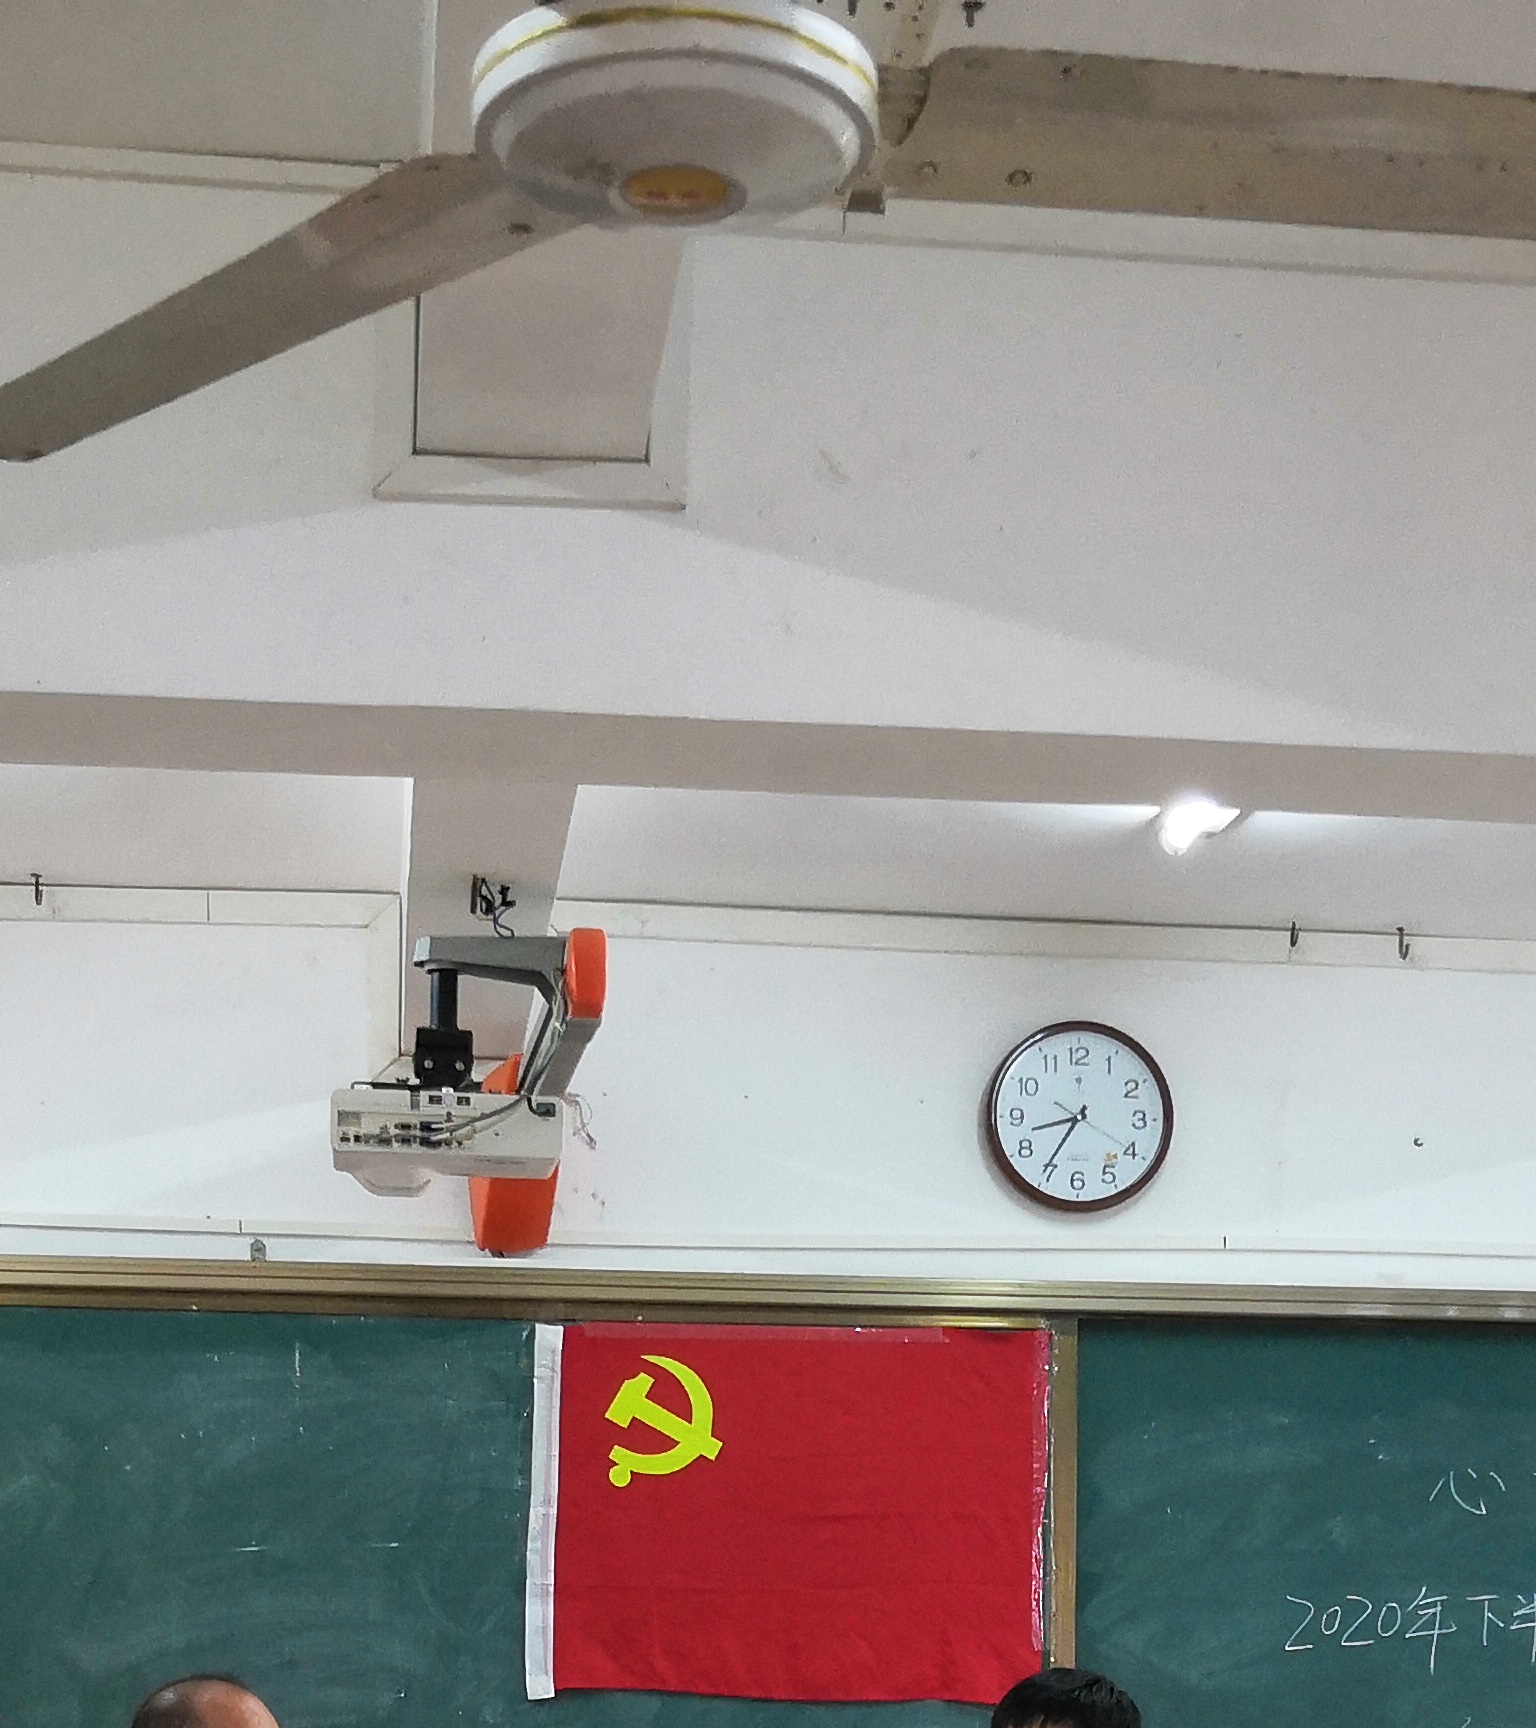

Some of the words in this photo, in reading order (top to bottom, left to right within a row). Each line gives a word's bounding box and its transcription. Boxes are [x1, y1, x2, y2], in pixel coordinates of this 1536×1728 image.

[1043, 1054, 1058, 1073] 11
[1068, 1046, 1090, 1066] 12
[1105, 1055, 1112, 1075] 1
[1018, 1077, 1039, 1097] 10
[1123, 1078, 1139, 1099] 2
[1009, 1107, 1024, 1127] 9
[1131, 1110, 1148, 1130] 3
[1018, 1138, 1033, 1158] 8
[1123, 1141, 1139, 1160] 4
[1043, 1162, 1058, 1183] 7
[1070, 1170, 1085, 1190] 6
[1101, 1163, 1117, 1184] 5
